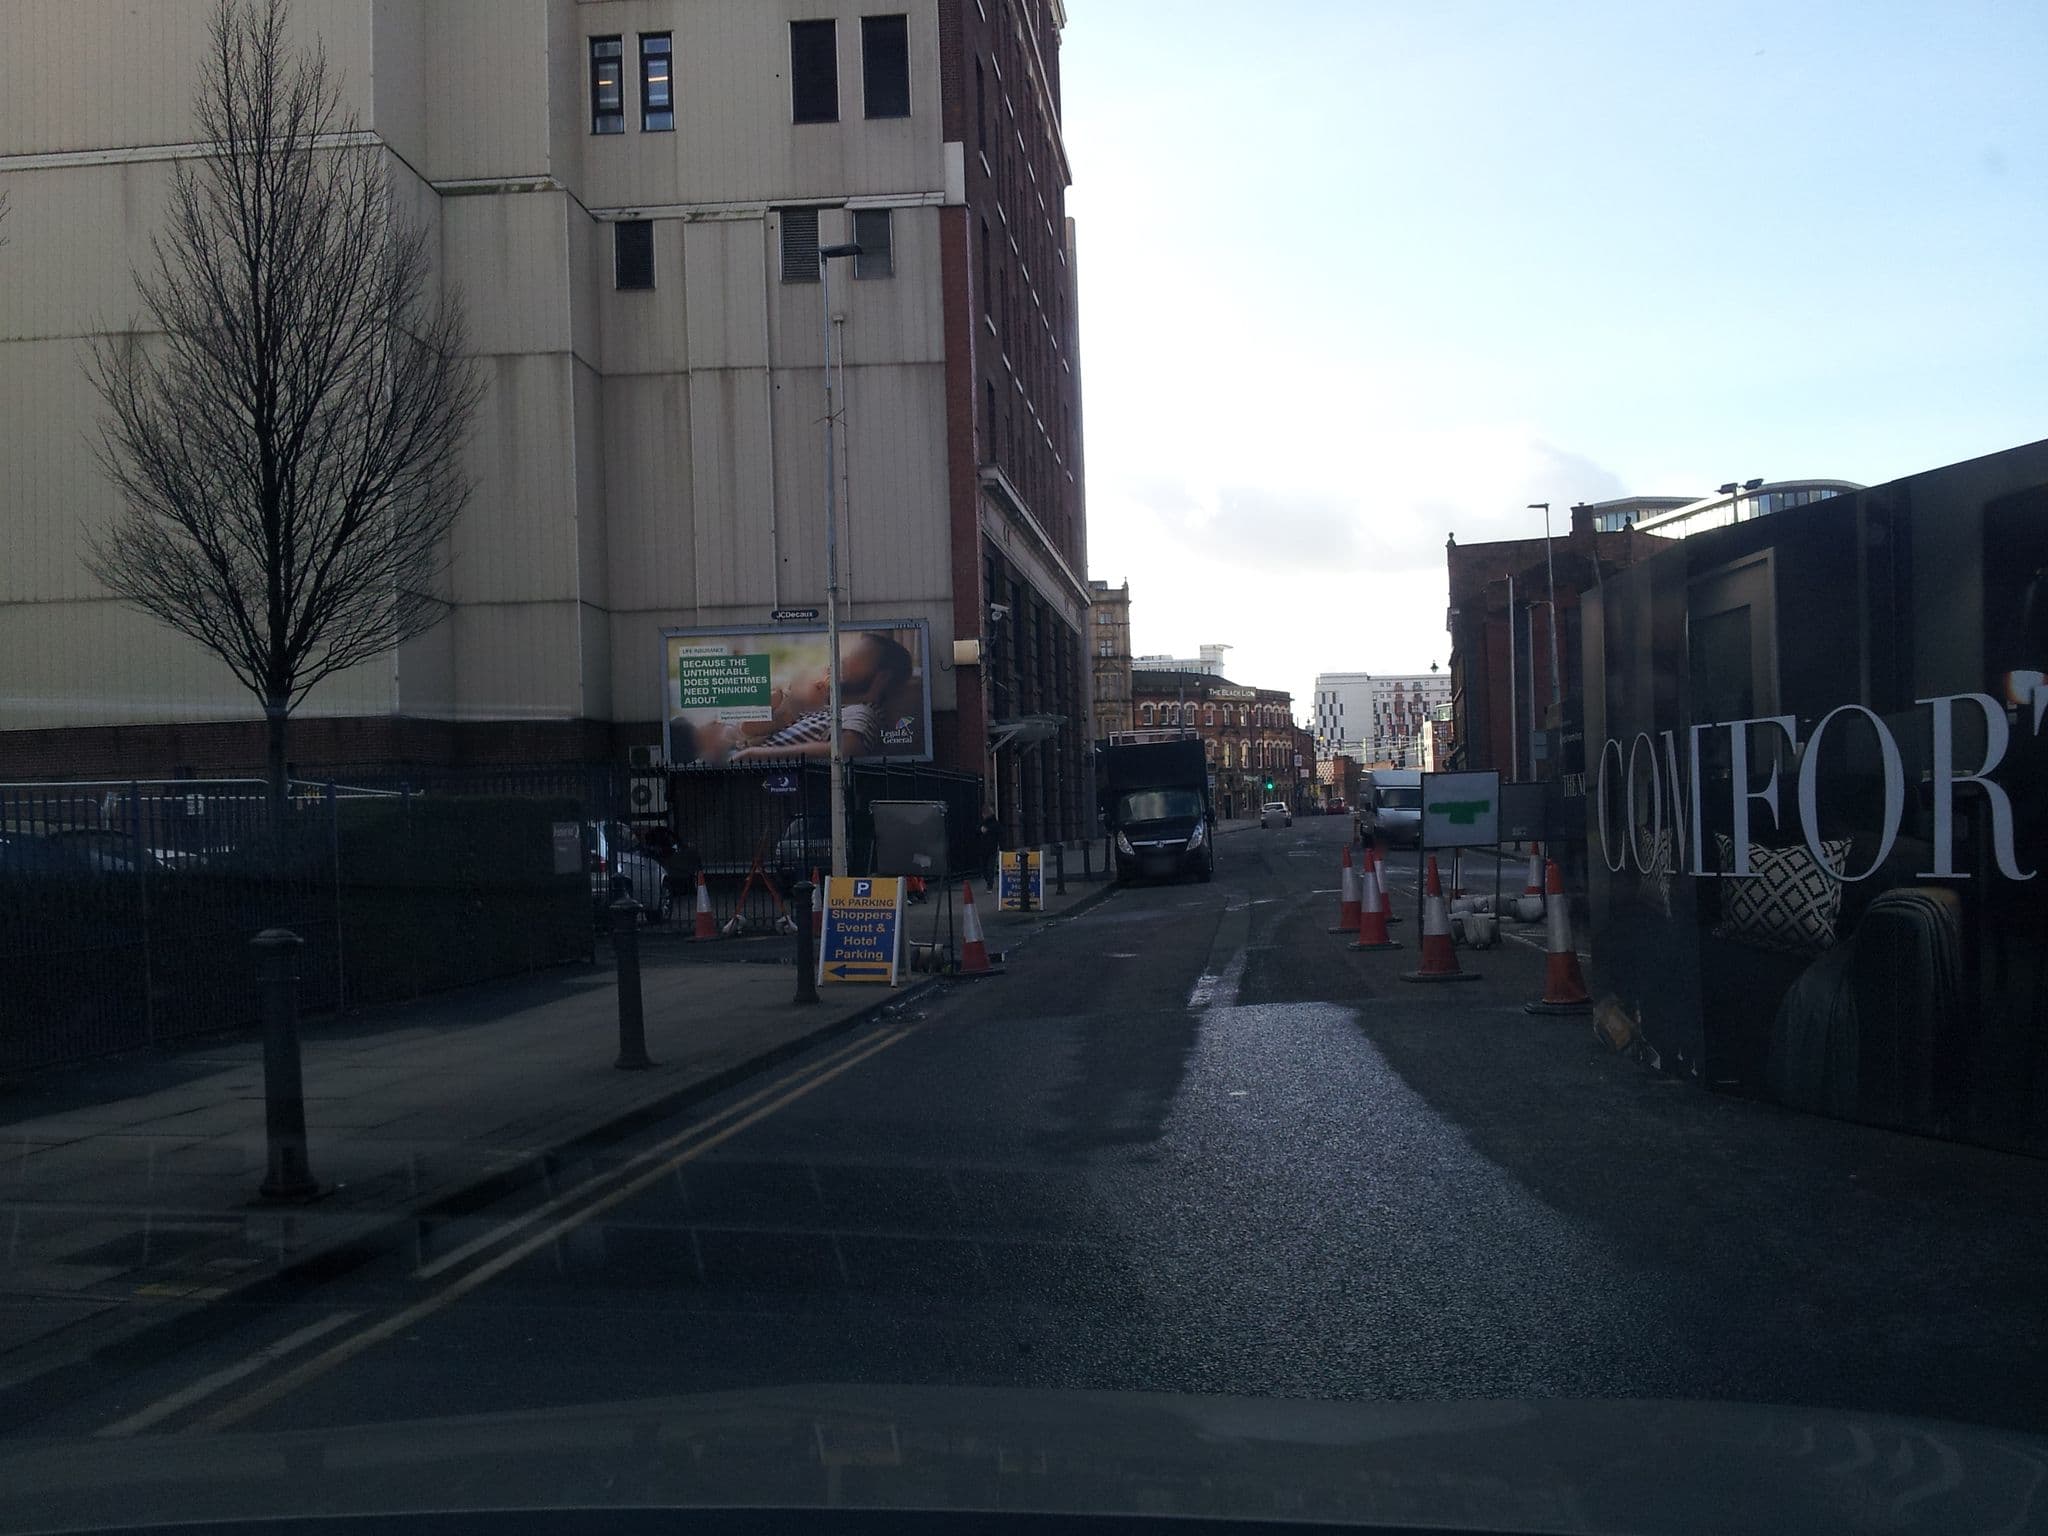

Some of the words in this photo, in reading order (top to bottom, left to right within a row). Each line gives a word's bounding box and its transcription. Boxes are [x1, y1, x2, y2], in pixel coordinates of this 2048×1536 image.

[776, 611, 813, 619] JCDecaux
[683, 659, 727, 668] BECAUSE
[729, 658, 748, 667] THE
[683, 667, 750, 677] UNTHINKABLE
[684, 678, 709, 686] DOES
[712, 676, 768, 686] SOMETIMES
[684, 687, 709, 696] NEED
[712, 685, 758, 695] THINKING
[1208, 688, 1221, 696] THE
[684, 696, 719, 705] ABOUT.
[880, 729, 900, 738] Legal
[883, 736, 912, 744] General
[1597, 686, 2048, 882] COMFOR
[857, 882, 870, 895] P
[849, 899, 894, 907] PARKING
[832, 910, 893, 921] Shoppers
[836, 923, 873, 933] Event
[876, 923, 886, 933] &
[844, 936, 877, 945] Hotel
[835, 950, 884, 961] Parking
